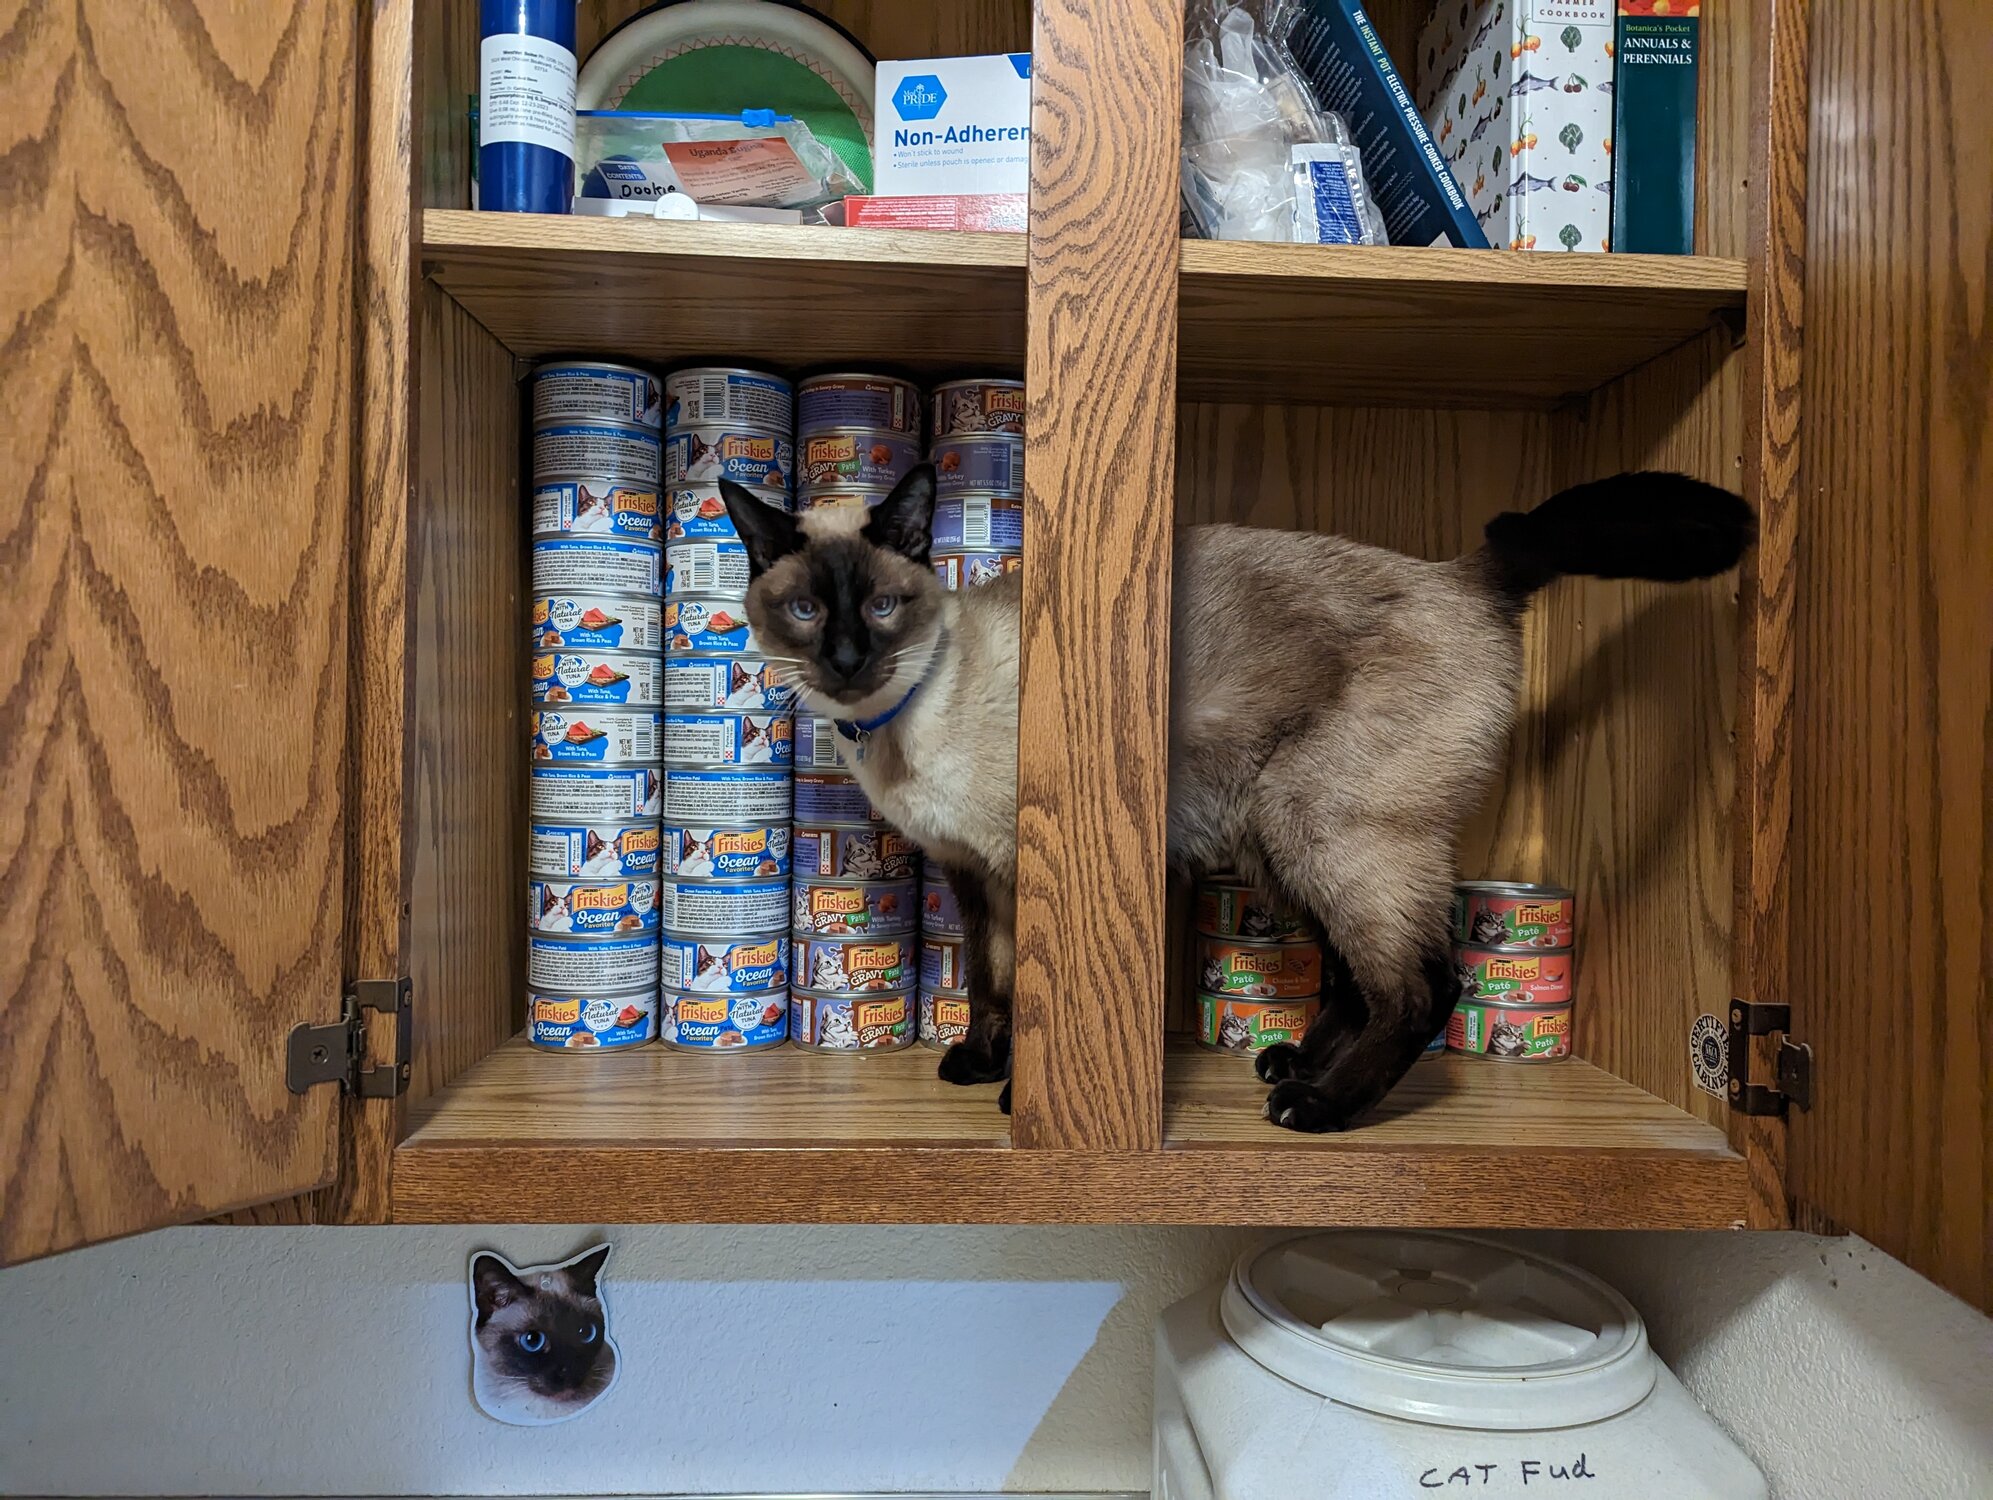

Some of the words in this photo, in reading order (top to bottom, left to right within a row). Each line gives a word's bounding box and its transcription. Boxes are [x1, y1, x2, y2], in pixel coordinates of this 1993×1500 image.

[1539, 9, 1606, 19] COOKBOOK
[1625, 24, 1663, 33] Botanica's
[1665, 25, 1691, 33] Pocket
[1624, 38, 1678, 49] ANNUALS
[1680, 39, 1692, 49] &
[1623, 54, 1692, 65] PERENNIALS
[903, 93, 937, 105] PRIDE
[1352, 9, 1367, 26] THE
[1360, 25, 1383, 57] INSTANT
[1386, 74, 1409, 108] ELECTRIC
[1403, 106, 1430, 145] PRESSURE
[1423, 143, 1445, 172] COOKER
[1438, 168, 1466, 211] COOKBOOK
[894, 125, 1031, 147] Non-Adheren
[690, 147, 728, 159] Uganda
[897, 149, 917, 158] Won't
[917, 149, 933, 157] stick
[934, 149, 941, 157] to
[942, 147, 964, 155] wound
[897, 161, 919, 169] Sterile
[942, 159, 963, 168] pouch
[971, 158, 996, 166] opened
[1005, 156, 1029, 165] damag
[607, 172, 645, 180] CONTENTS:
[988, 413, 1021, 427] GRAVY
[727, 441, 772, 459] Friskies
[810, 444, 851, 461] Friskies
[727, 459, 769, 473] Ocean
[809, 462, 836, 479] GRAVY
[841, 463, 856, 472] Paté
[862, 465, 877, 473] With
[735, 471, 763, 479] Favorites
[617, 495, 655, 513] Friskies
[617, 512, 654, 527] Ocean
[550, 608, 582, 619] Natural
[679, 611, 710, 622] Natural
[555, 663, 590, 675] Natural
[542, 721, 568, 733] Natural
[626, 836, 658, 849] Friskies
[718, 837, 763, 853] Friskies
[625, 851, 656, 867] Ocean
[718, 854, 760, 869] Ocean
[883, 856, 909, 872] GRAVY
[576, 892, 625, 908] Friskies
[816, 894, 860, 911] Friskies
[576, 910, 621, 925] Ocean
[814, 913, 846, 928] GRAVY
[850, 914, 865, 922] Paté
[1519, 908, 1560, 924] Friskies
[584, 921, 614, 929] Favorites
[1517, 927, 1540, 938] Paté
[735, 949, 776, 967] Friskies
[854, 953, 897, 967] Friskies
[1233, 956, 1280, 972] Friskies
[735, 967, 774, 982] Ocean
[1489, 962, 1537, 979] Friskies
[742, 979, 769, 987] Favorites
[850, 970, 885, 986] GRAVY
[1232, 975, 1254, 985] Paté
[1487, 982, 1511, 992] Paté
[1530, 984, 1550, 992] Salmon
[537, 1004, 576, 1021] Friskies
[581, 1007, 619, 1021] Natural
[681, 1004, 724, 1021] Friskies
[728, 1006, 764, 1019] Natural
[736, 1003, 752, 1011] WITH
[940, 1007, 970, 1021] Friski
[863, 1007, 903, 1025] Friskies
[1262, 1014, 1305, 1029] Friskies
[536, 1021, 573, 1037] Ocean
[680, 1022, 721, 1036] Ocean
[860, 1025, 893, 1043] GRAVY
[938, 1025, 968, 1040] GRAVY
[1536, 1020, 1569, 1037] Friskies
[541, 1035, 566, 1043] Favorites
[1261, 1032, 1283, 1043] Paté
[1535, 1038, 1554, 1050] Paté
[1419, 1464, 1497, 1488] CAT
[1521, 1452, 1596, 1485] Fud
